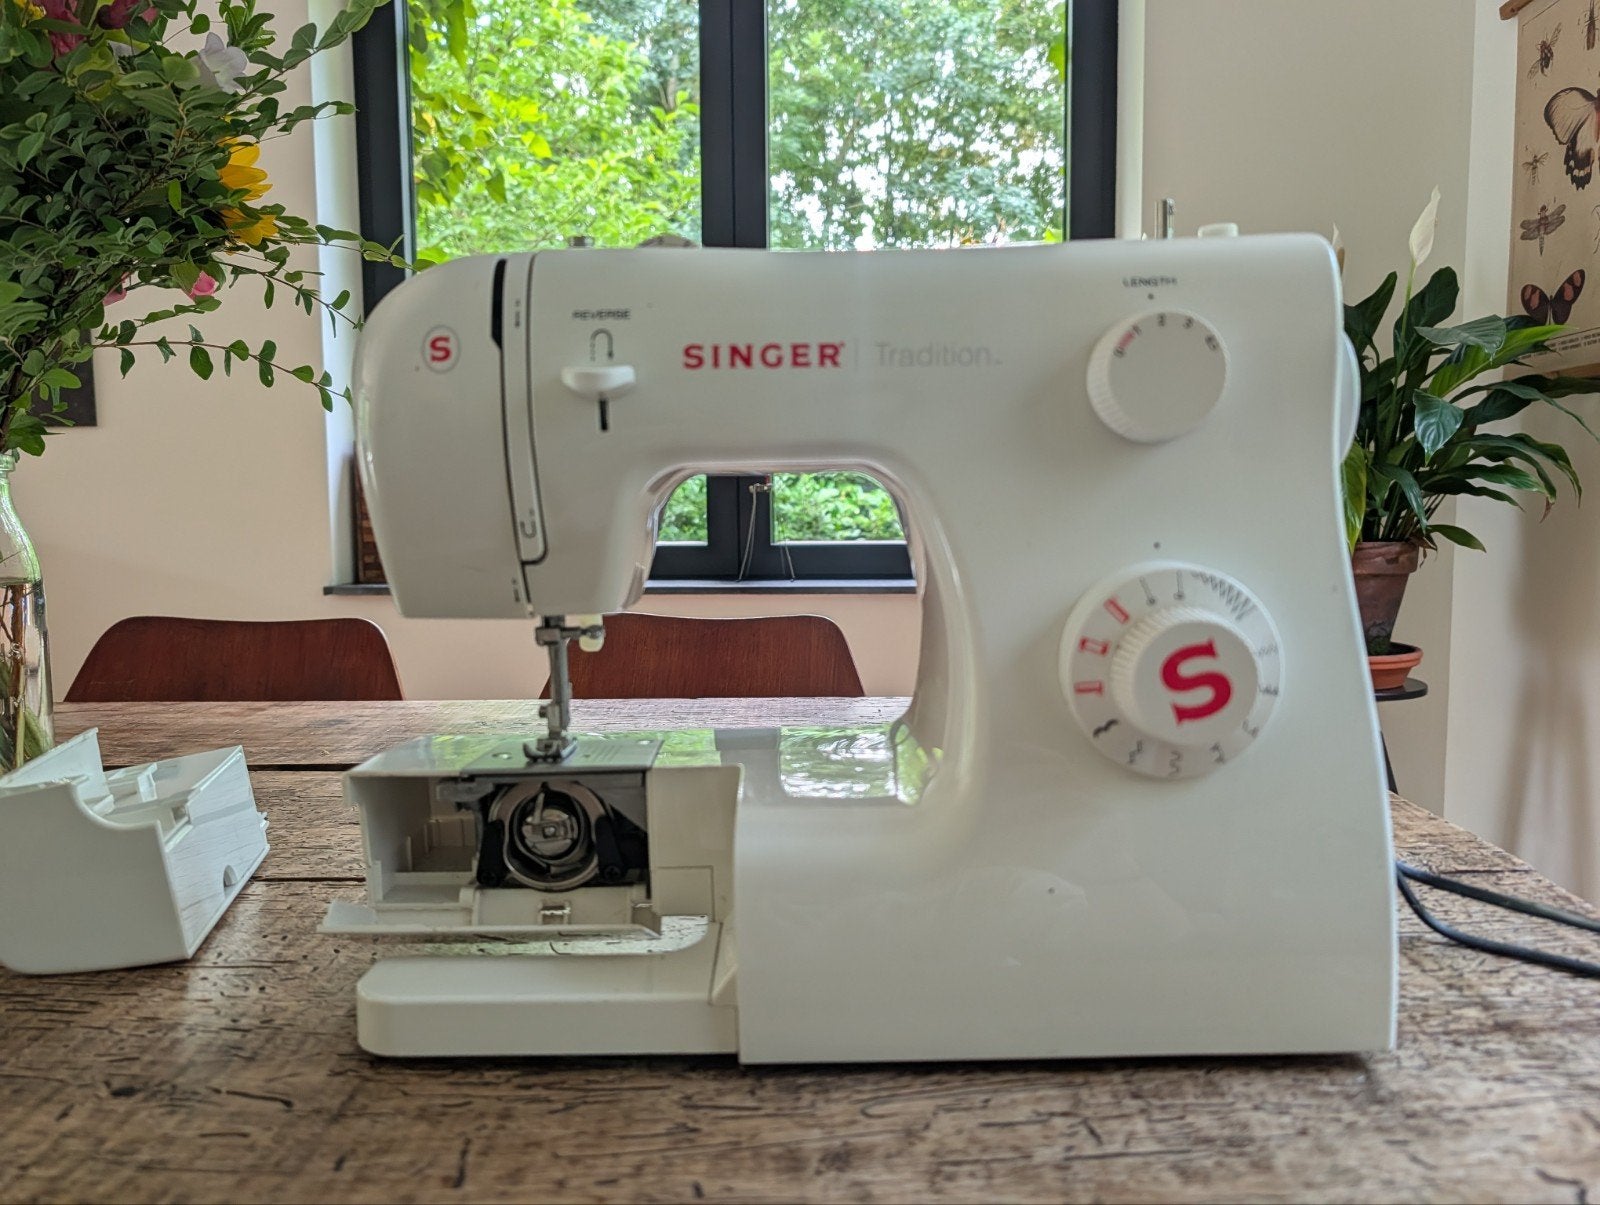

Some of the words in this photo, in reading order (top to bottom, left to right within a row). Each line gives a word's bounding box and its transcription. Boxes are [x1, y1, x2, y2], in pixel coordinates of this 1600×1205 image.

[572, 309, 632, 320] REVERSE
[429, 336, 452, 362] S
[683, 342, 844, 369] SINGER
[1161, 638, 1231, 726] S
